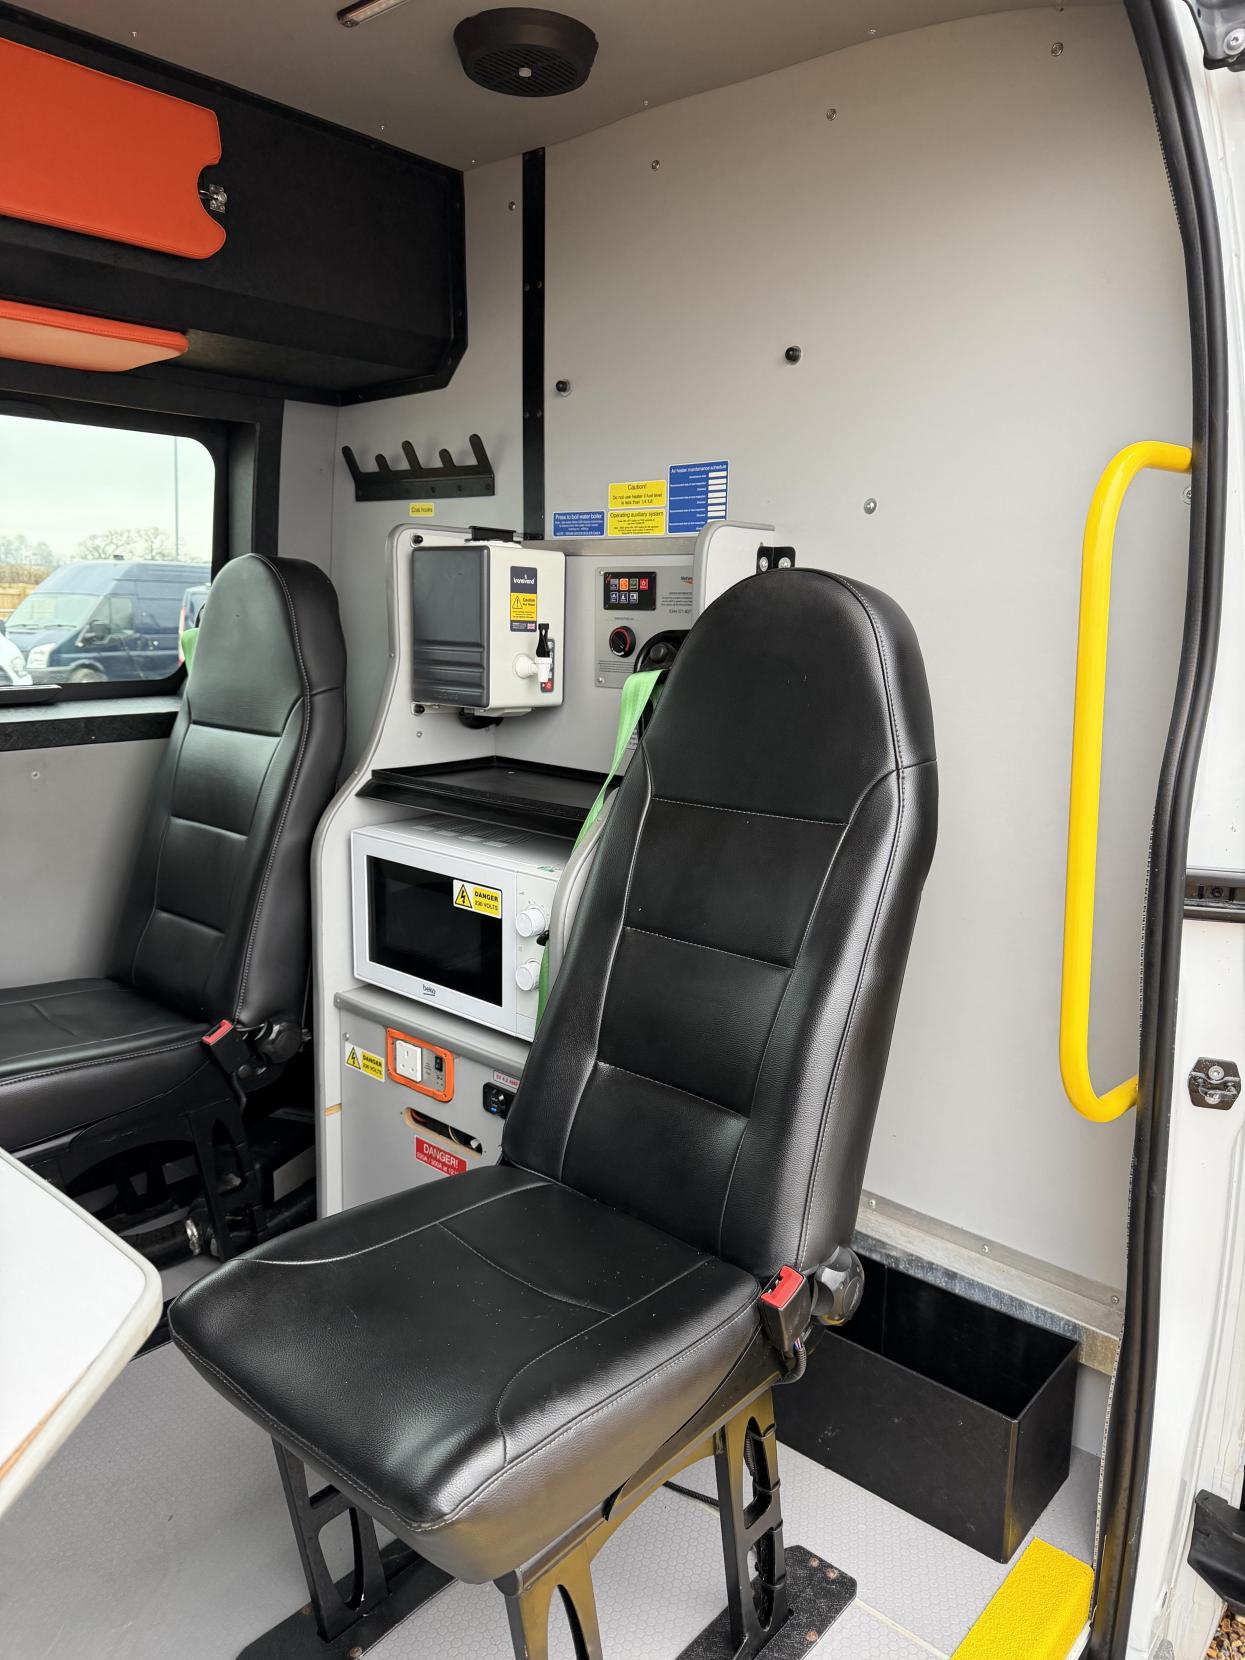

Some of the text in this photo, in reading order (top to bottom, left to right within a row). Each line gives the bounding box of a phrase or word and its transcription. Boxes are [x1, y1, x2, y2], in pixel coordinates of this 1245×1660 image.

[474, 890, 499, 902] DANGER
[484, 902, 498, 911] VOLTS
[422, 983, 436, 995] beko
[362, 1054, 383, 1067] DANGER
[423, 1143, 459, 1169] DANGER!
